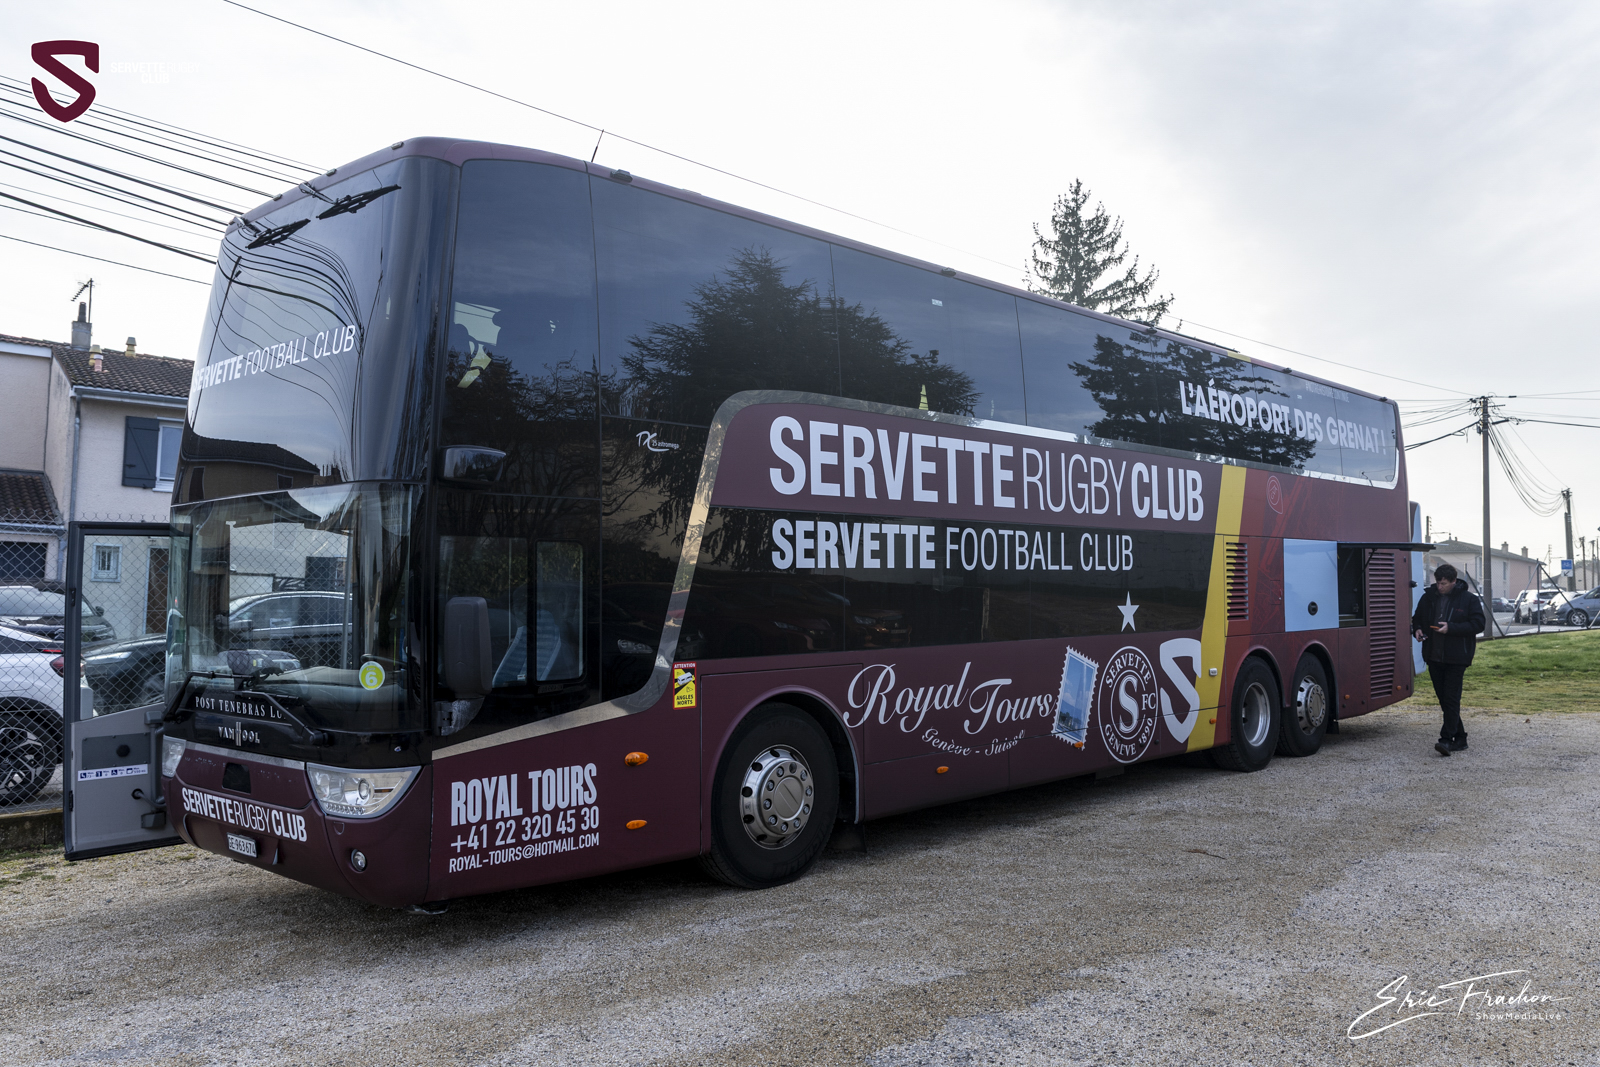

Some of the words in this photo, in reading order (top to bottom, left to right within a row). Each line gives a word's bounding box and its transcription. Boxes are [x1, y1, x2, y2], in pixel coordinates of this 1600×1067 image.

[192, 354, 244, 393] SERVETTE
[244, 336, 309, 376] FOOTBALL
[313, 324, 356, 359] CLUB
[1293, 407, 1324, 443] DES
[769, 415, 1016, 509] SERVETTE
[1022, 447, 1127, 516] RUGBY
[1131, 461, 1205, 522] CLUB
[771, 518, 936, 570] SERVETTE
[945, 526, 1073, 571] FOOTBALL
[1080, 532, 1134, 571] CLUB
[365, 671, 378, 687] 6
[1105, 652, 1152, 688] SERVETTE
[195, 696, 215, 710] POST
[218, 699, 266, 717] TENEBRAS
[843, 661, 972, 733] Royal
[963, 678, 1057, 735] Tours
[1118, 674, 1140, 734] S
[1141, 692, 1156, 711] FC
[984, 729, 1026, 756] Suisse
[1138, 717, 1153, 744] 1890
[182, 787, 236, 825] SERVETTE
[233, 801, 271, 833] RUGBY
[271, 809, 308, 842] CLUB
[451, 773, 523, 827] ROYAL
[528, 762, 598, 814] TOURS
[450, 823, 488, 853] +41
[495, 819, 516, 847] 22
[521, 813, 552, 841] 320
[556, 809, 576, 835] 45
[580, 805, 600, 831] 30
[449, 832, 600, 873] ROYAL-TOURS@HOTMAIL.COM
